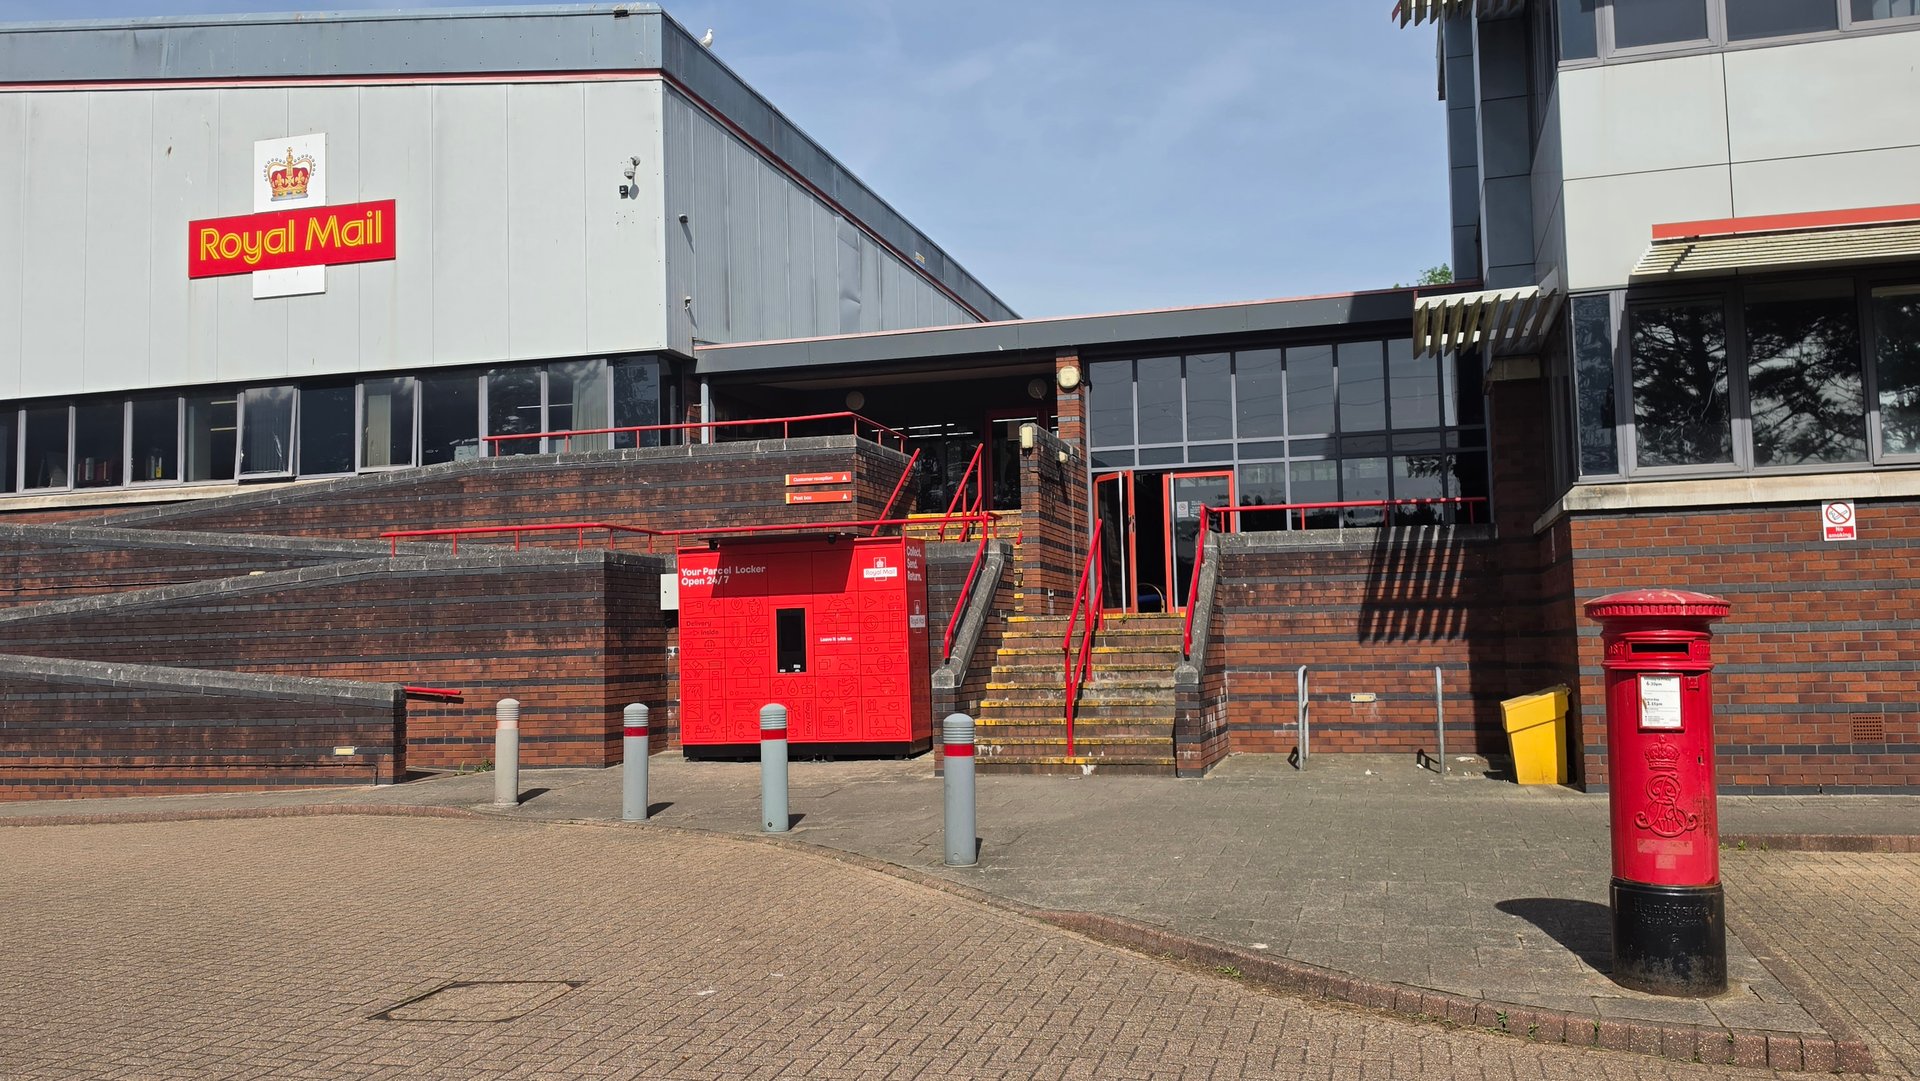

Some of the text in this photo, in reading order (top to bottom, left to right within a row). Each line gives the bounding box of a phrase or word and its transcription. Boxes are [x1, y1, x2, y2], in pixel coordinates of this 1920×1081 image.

[200, 209, 382, 265] Royal Mail
[681, 565, 766, 576] Your Parcel Locker
[865, 569, 882, 577] Royal
[681, 575, 729, 587] Open 24/7
